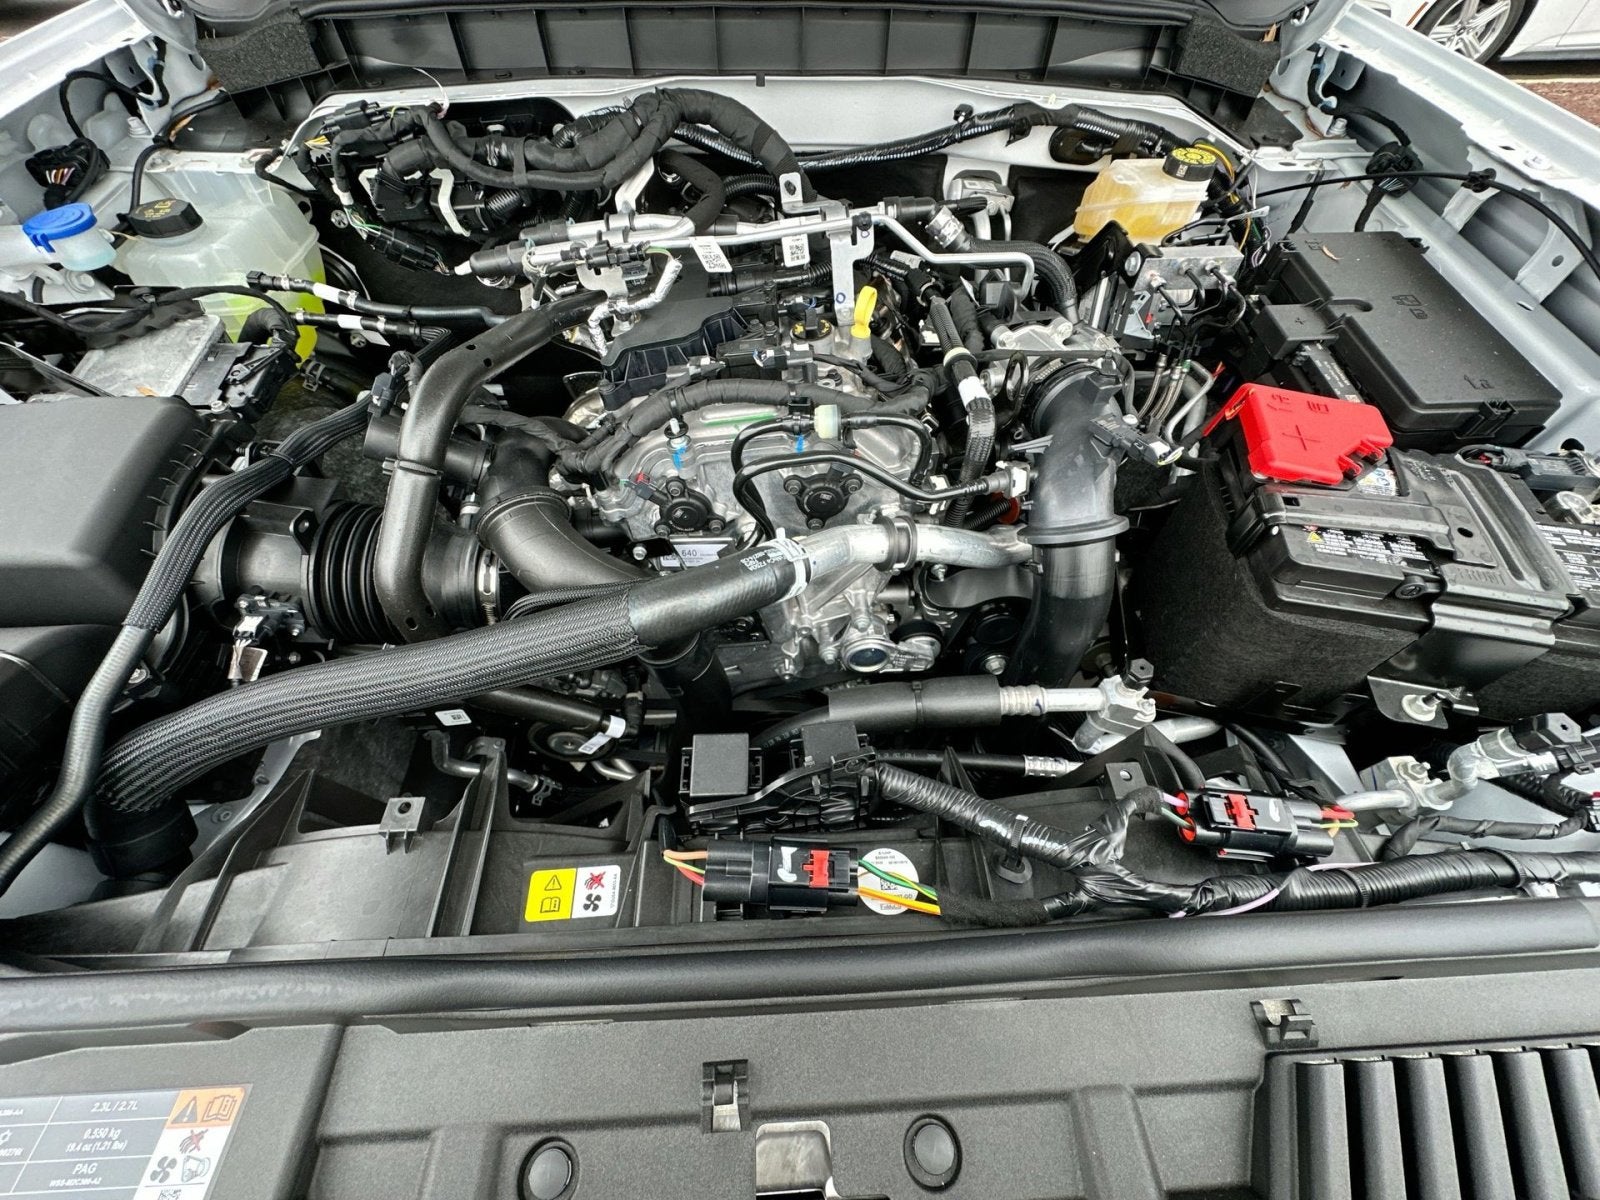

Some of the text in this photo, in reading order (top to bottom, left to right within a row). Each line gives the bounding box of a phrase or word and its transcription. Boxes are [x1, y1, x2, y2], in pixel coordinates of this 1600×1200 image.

[681, 549, 698, 557] 640
[91, 1101, 112, 1112] 2.3L
[118, 1100, 138, 1111] 2.7L
[83, 1127, 122, 1141] 0.550 kg
[72, 1162, 99, 1175] PAG
